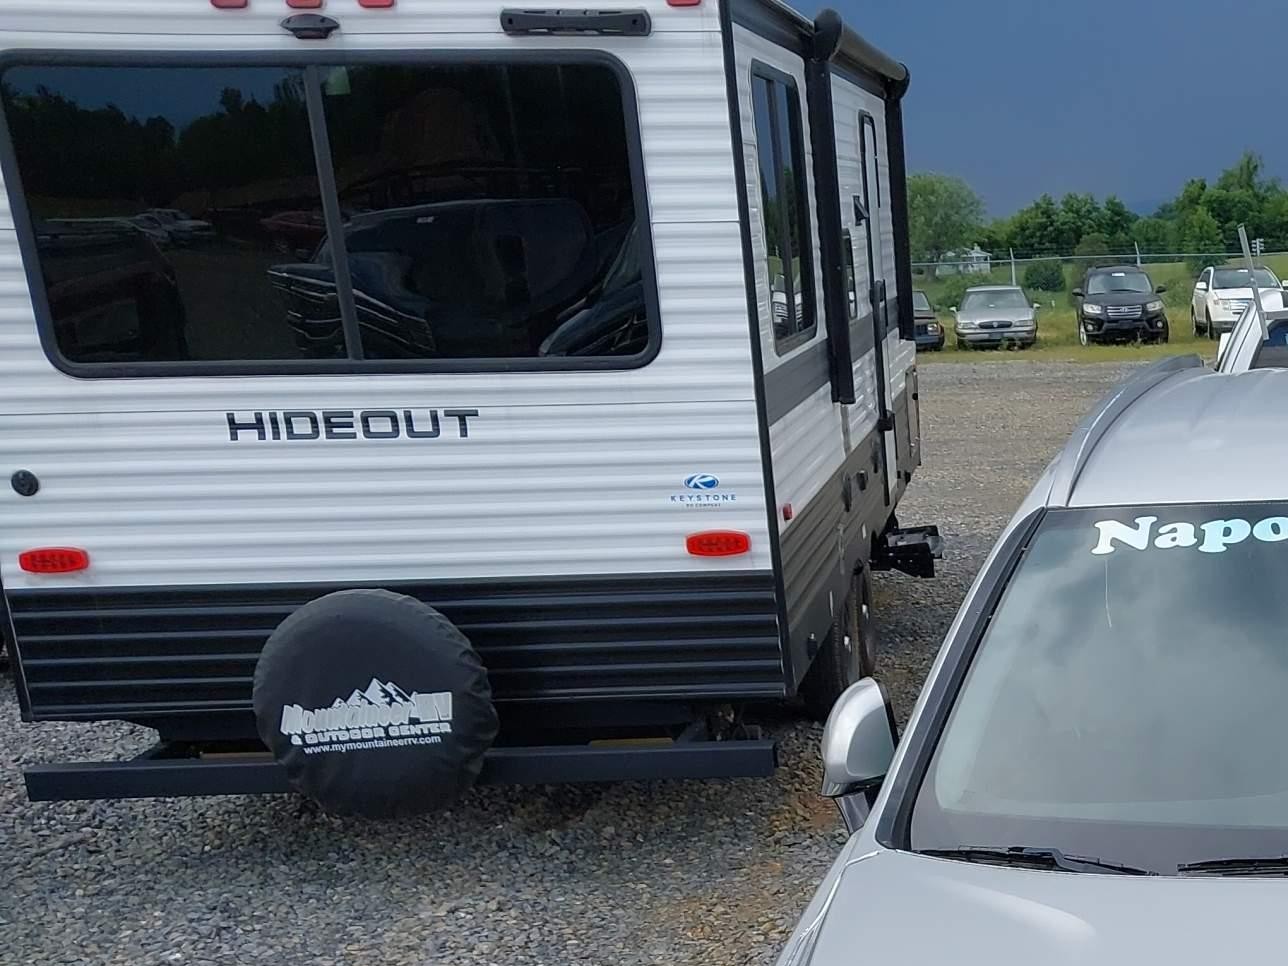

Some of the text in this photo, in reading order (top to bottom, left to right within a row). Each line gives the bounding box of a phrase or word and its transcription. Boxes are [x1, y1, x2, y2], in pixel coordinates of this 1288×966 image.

[226, 409, 479, 441] HIDEOUT
[670, 494, 737, 502] KEYSTONE
[304, 727, 386, 744] OUTDOOR
[388, 722, 452, 737] CENTER
[303, 735, 441, 754] www.mymountaineerrv.com
